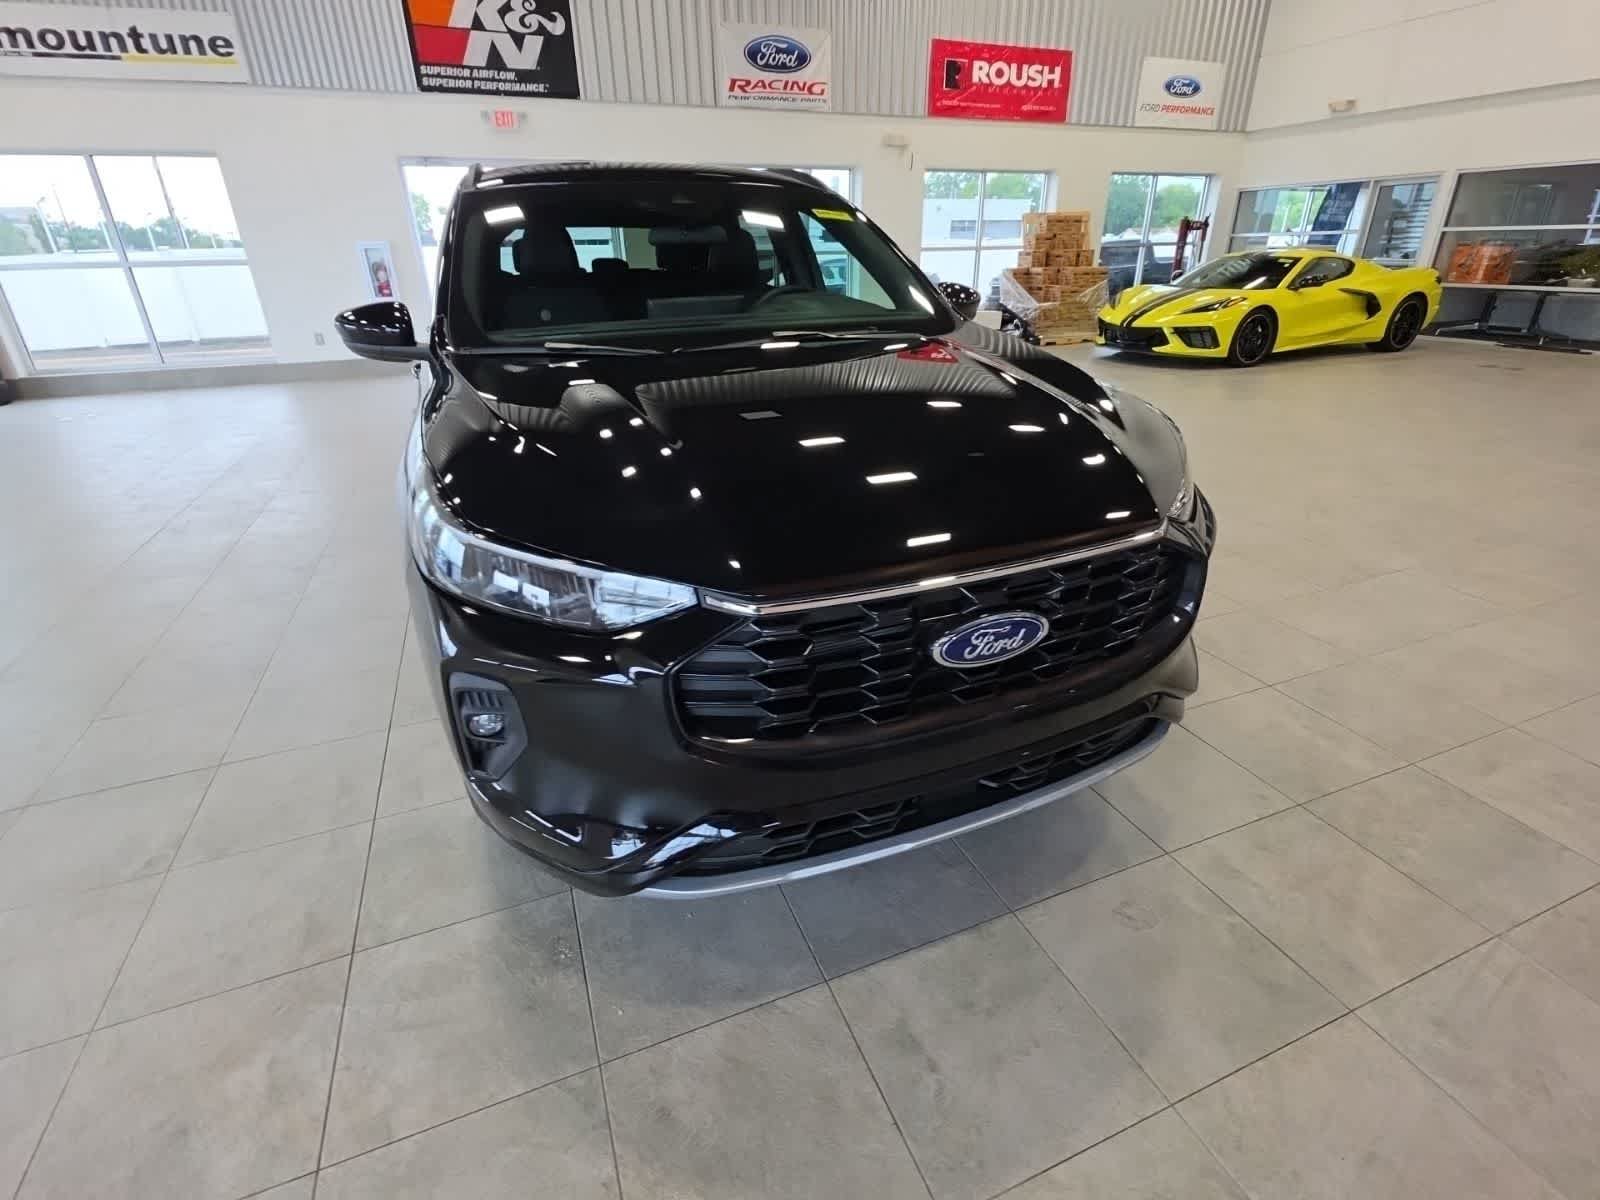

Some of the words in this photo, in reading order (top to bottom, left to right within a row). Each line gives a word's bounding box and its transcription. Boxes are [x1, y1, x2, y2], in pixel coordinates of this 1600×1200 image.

[0, 25, 235, 57] mountune
[756, 41, 799, 67] Ford
[419, 65, 471, 78] SUPERIOR
[472, 68, 518, 81] AIRFLOW.
[422, 77, 472, 89] SUPERIOR
[971, 60, 1062, 89] ROUSH
[727, 78, 828, 96] RACING
[1140, 103, 1161, 113] FORD
[1160, 104, 1216, 116] PERFORMANCE
[963, 625, 1027, 660] Ford
